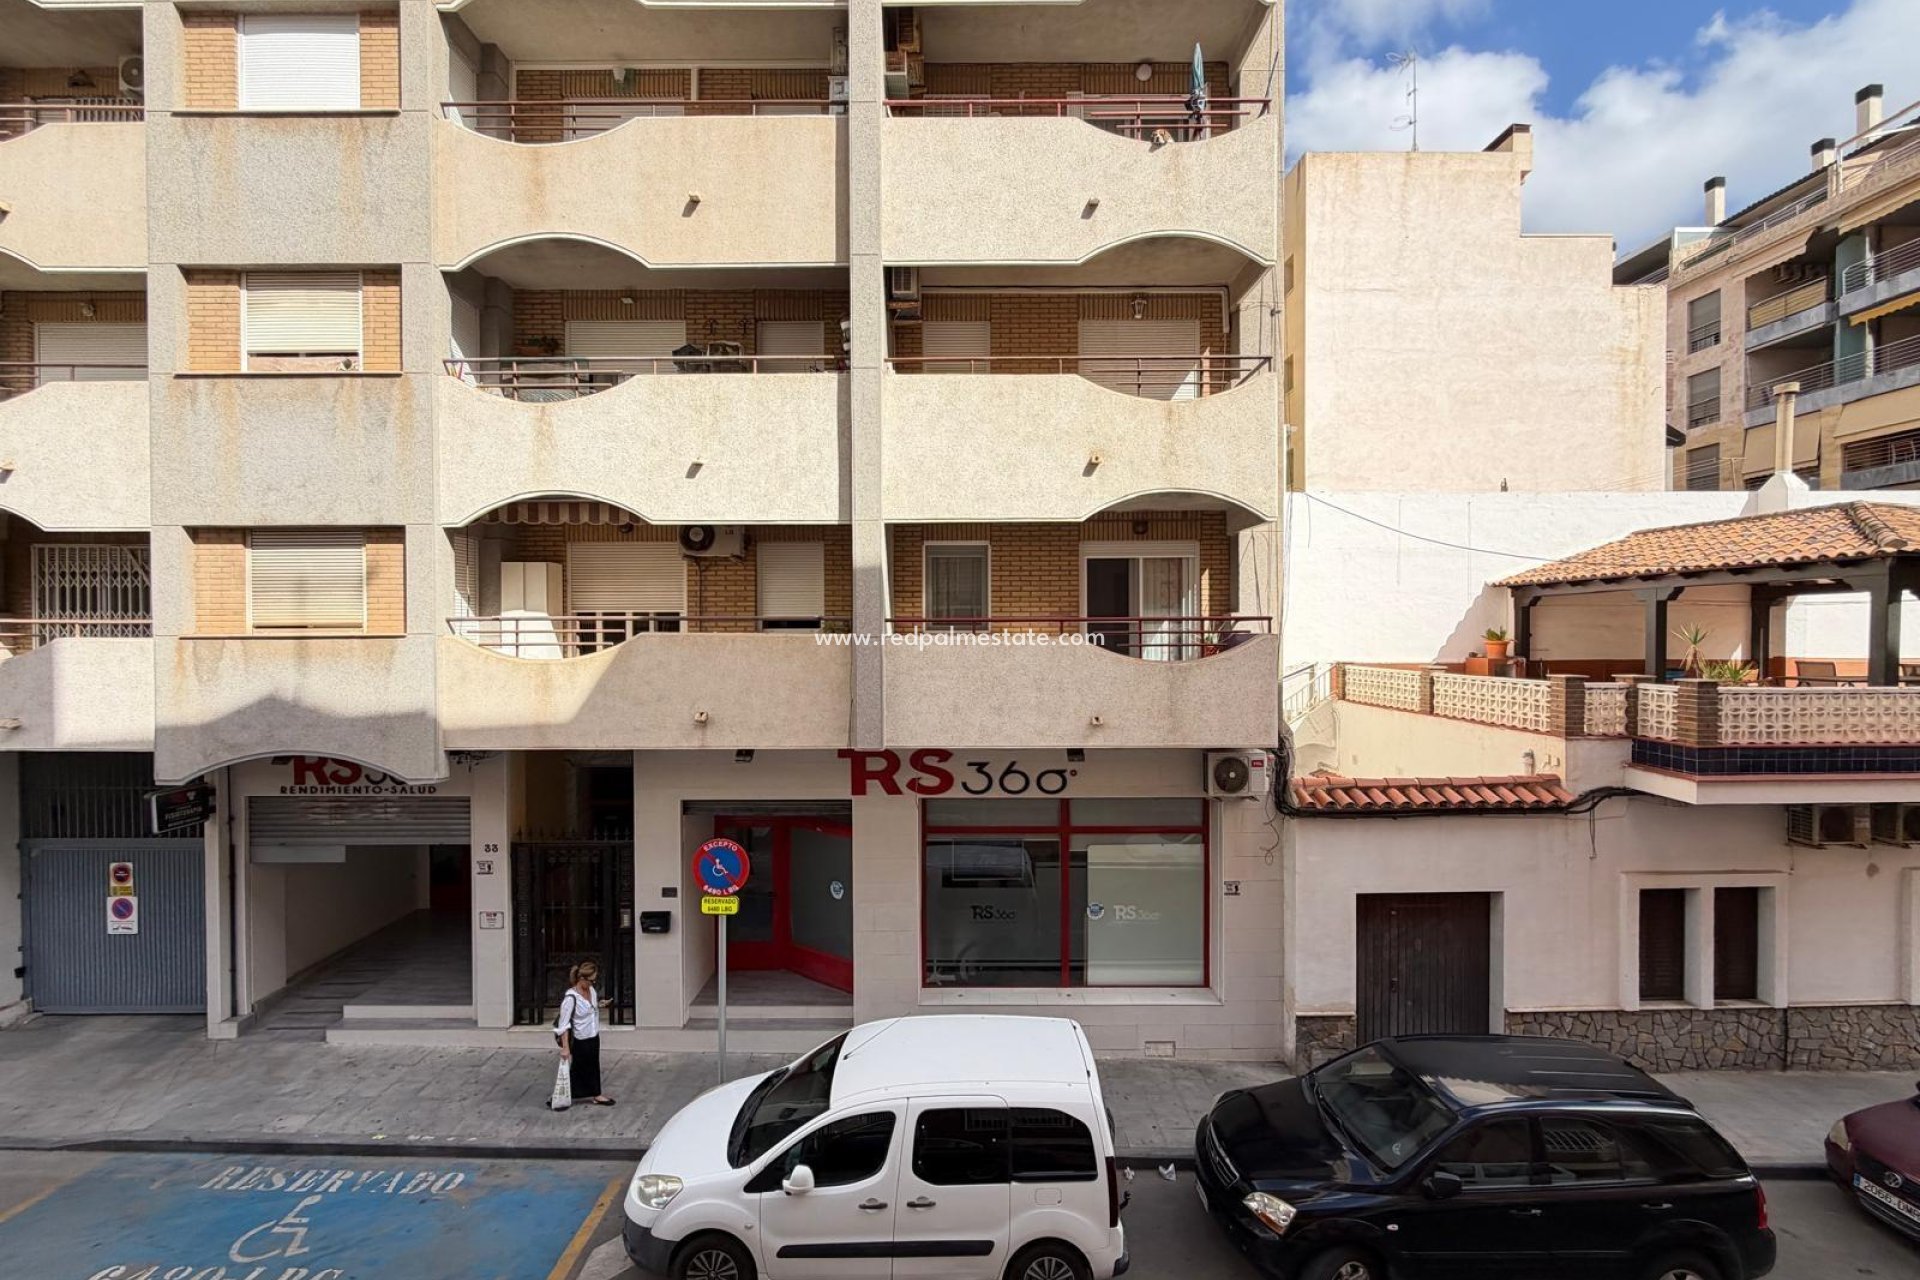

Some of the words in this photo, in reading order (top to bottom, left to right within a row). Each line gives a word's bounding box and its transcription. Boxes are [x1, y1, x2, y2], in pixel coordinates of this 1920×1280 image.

[280, 785, 437, 795] RENDIMIENTO-SALUD
[484, 844, 499, 853] 33
[703, 841, 738, 851] EXCEPTO
[199, 1166, 465, 1194] RESERVADO
